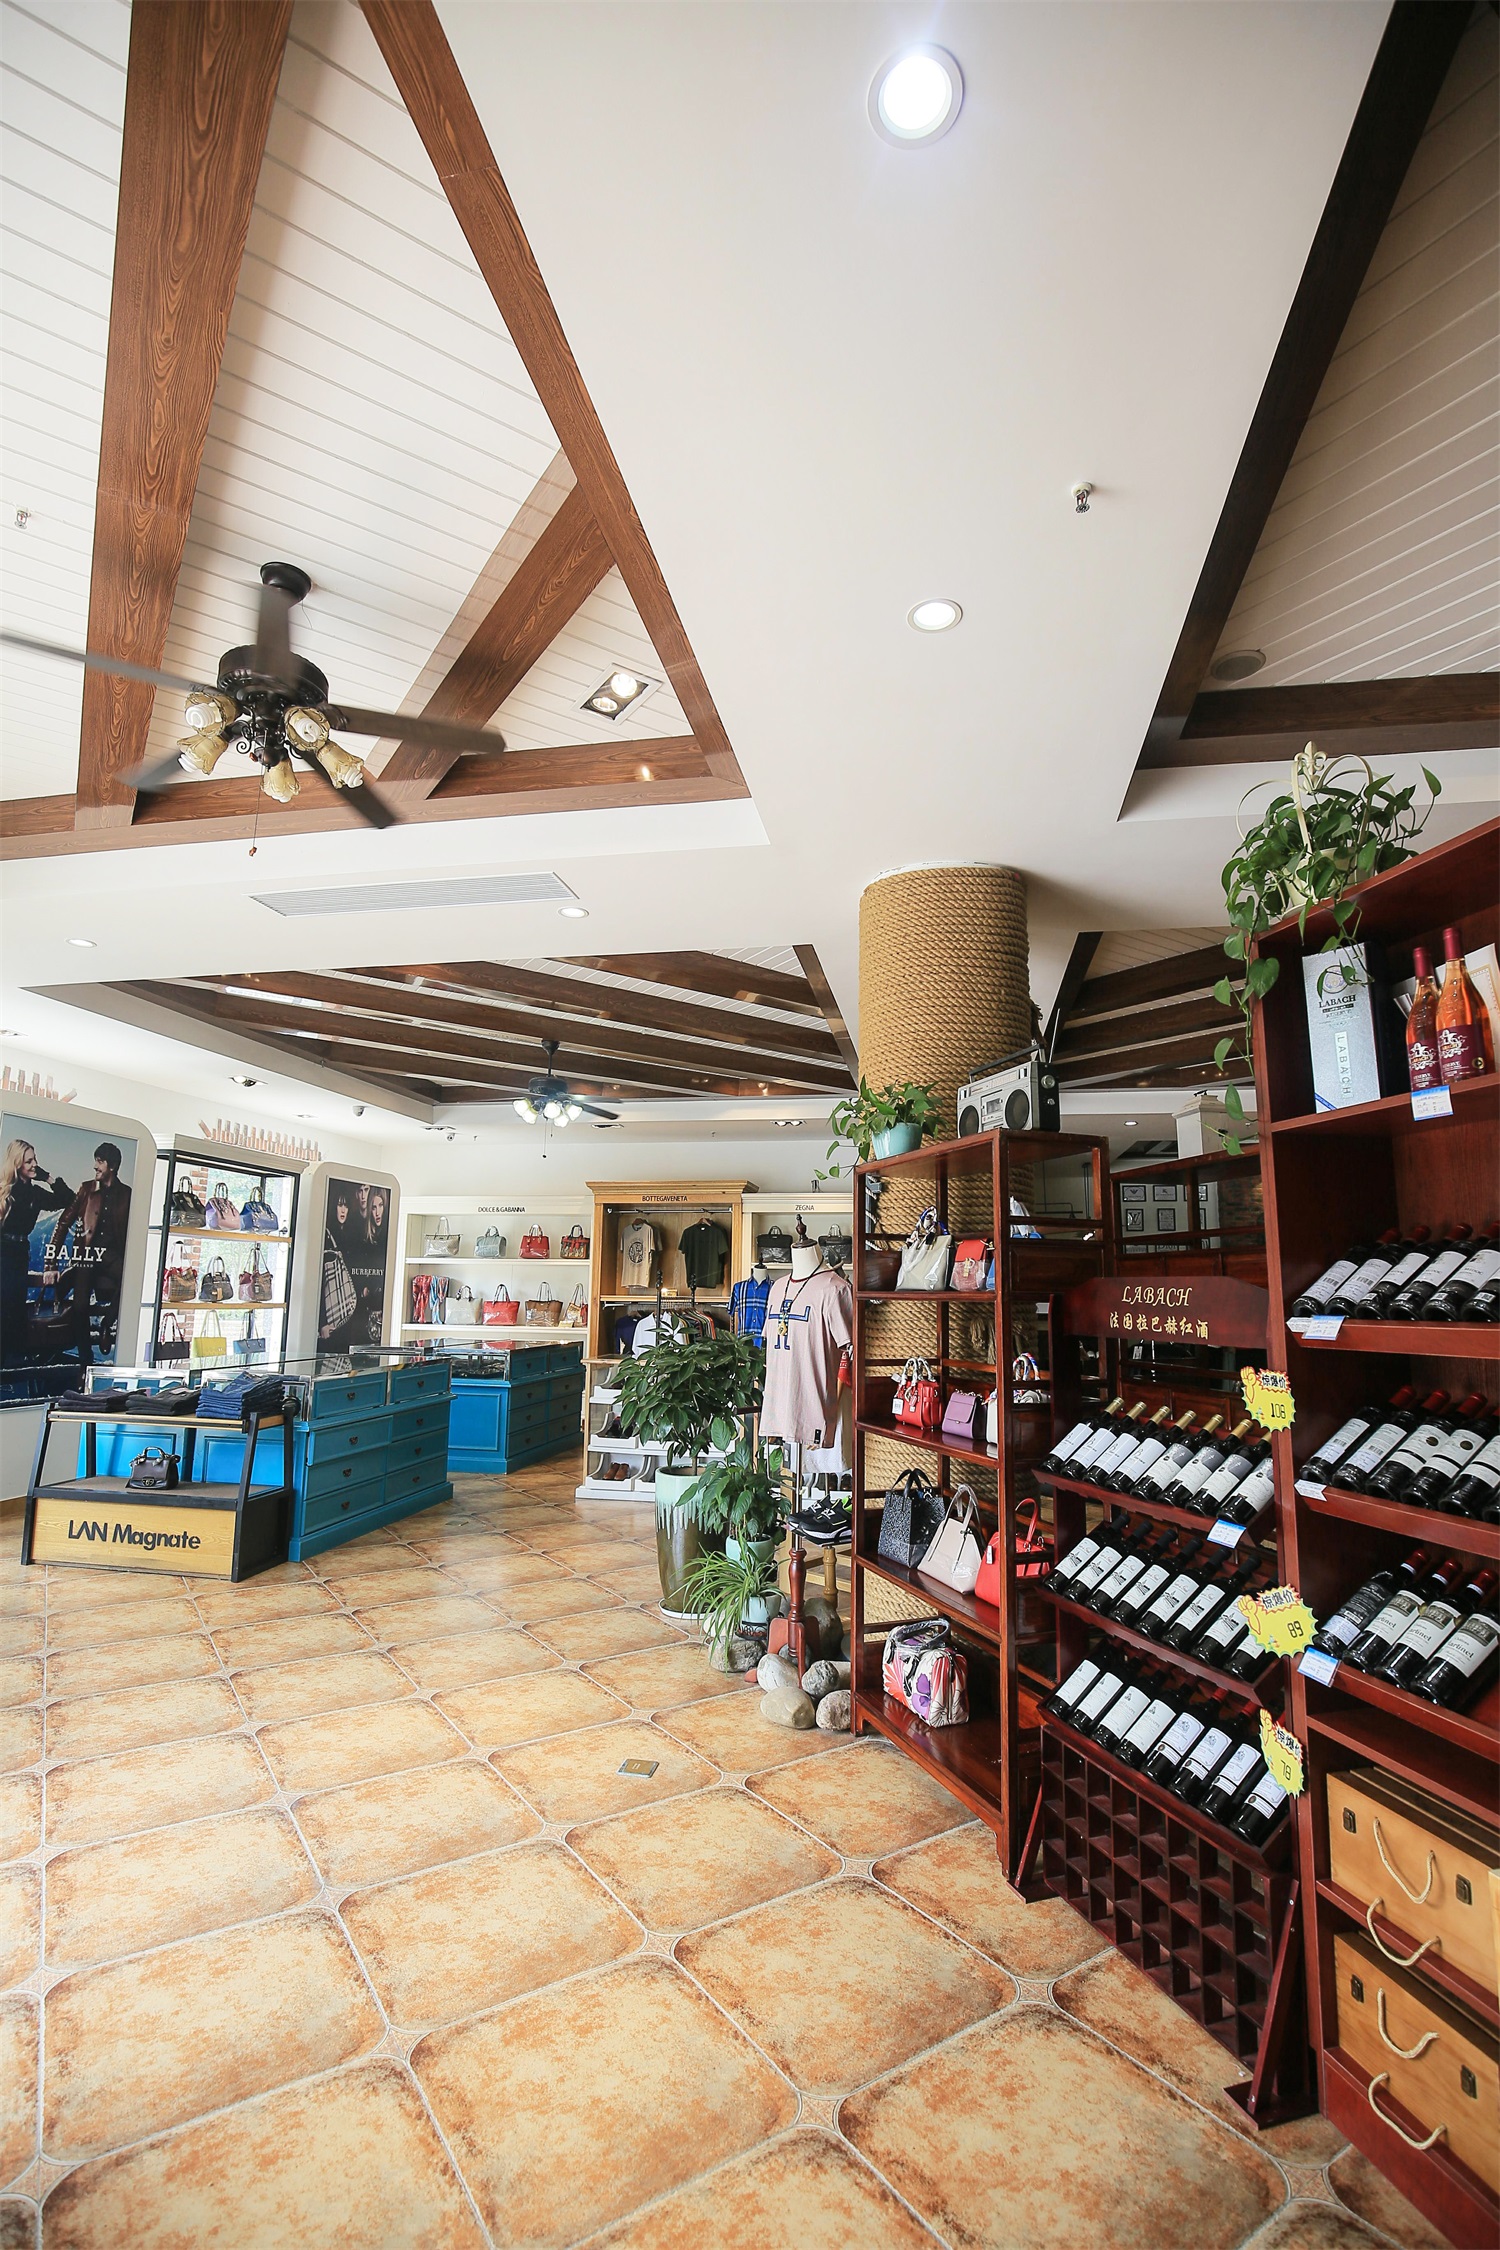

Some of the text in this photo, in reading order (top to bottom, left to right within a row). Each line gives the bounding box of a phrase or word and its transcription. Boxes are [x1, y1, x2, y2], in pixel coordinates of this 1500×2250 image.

[1319, 995, 1356, 1008] LABACH
[1337, 1036, 1351, 1094] LABACH
[44, 1243, 107, 1262] BALLY
[351, 1267, 385, 1276] BURBERRY
[1121, 1285, 1192, 1308] LABACH
[1109, 1311, 1209, 1340] 法国拉巴赫红酒
[1261, 1374, 1287, 1389] 惊爆价
[68, 1519, 201, 1551] LAN Magnate
[1262, 1589, 1295, 1610] 惊爆价
[1287, 1620, 1304, 1639] 89
[1281, 1759, 1292, 1781] 78
